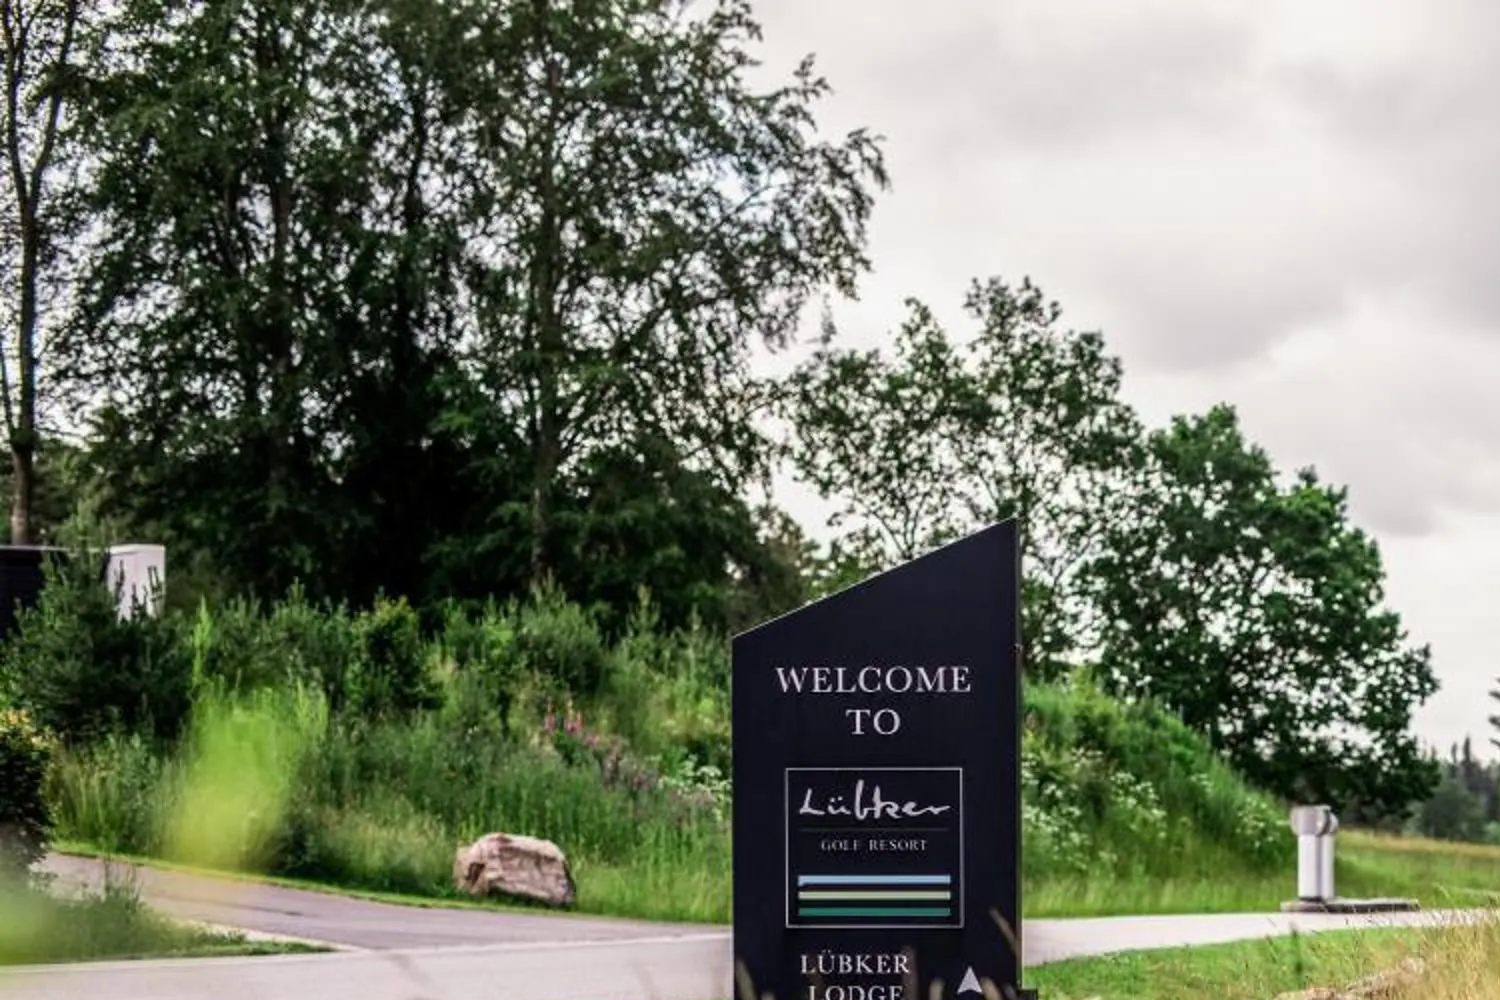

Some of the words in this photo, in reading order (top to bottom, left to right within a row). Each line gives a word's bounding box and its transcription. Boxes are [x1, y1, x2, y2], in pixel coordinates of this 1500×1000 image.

[776, 666, 971, 693] WELCOME
[846, 708, 900, 734] TO
[799, 779, 951, 820] Lübker
[820, 838, 861, 852] GOLF
[868, 838, 928, 852] RESORT
[800, 950, 909, 974] LÜBKER
